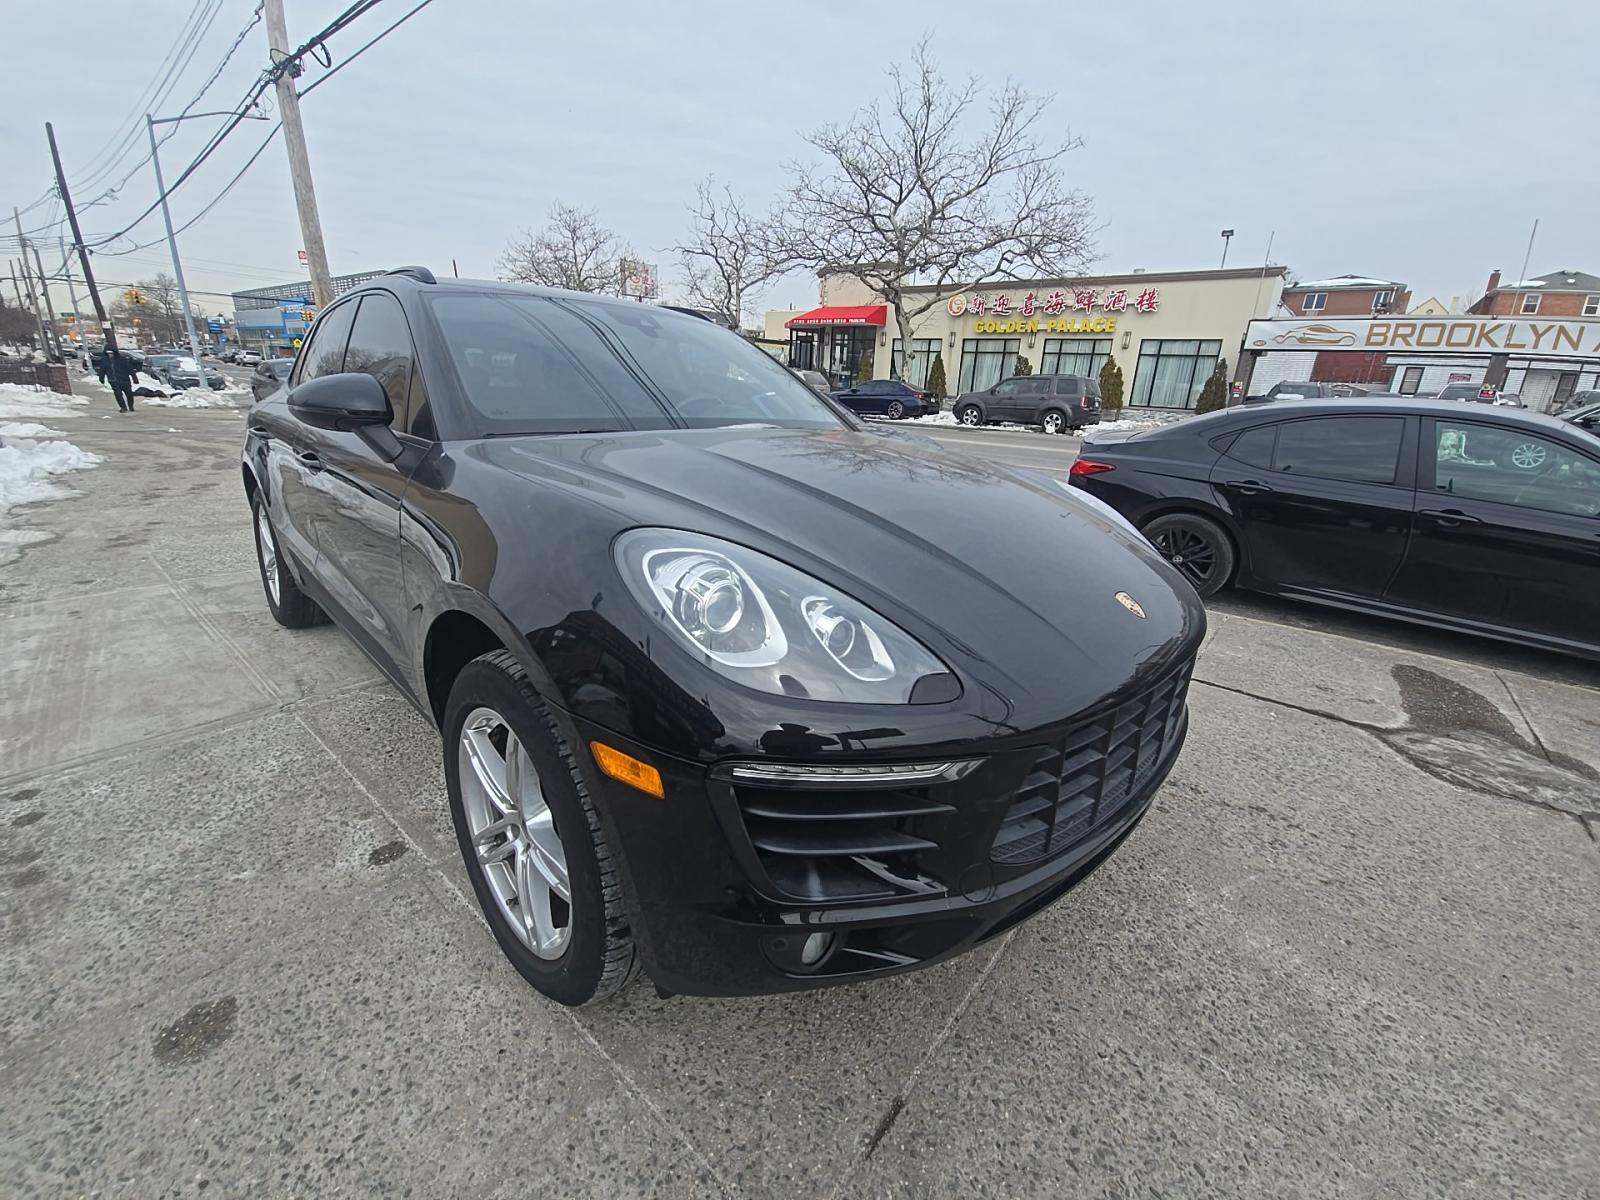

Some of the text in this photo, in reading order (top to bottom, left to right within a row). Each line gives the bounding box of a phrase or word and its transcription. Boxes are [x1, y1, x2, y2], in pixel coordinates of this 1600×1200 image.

[975, 317, 1118, 334] GOLDEN PALACE
[1364, 322, 1585, 351] BROOKLYN
